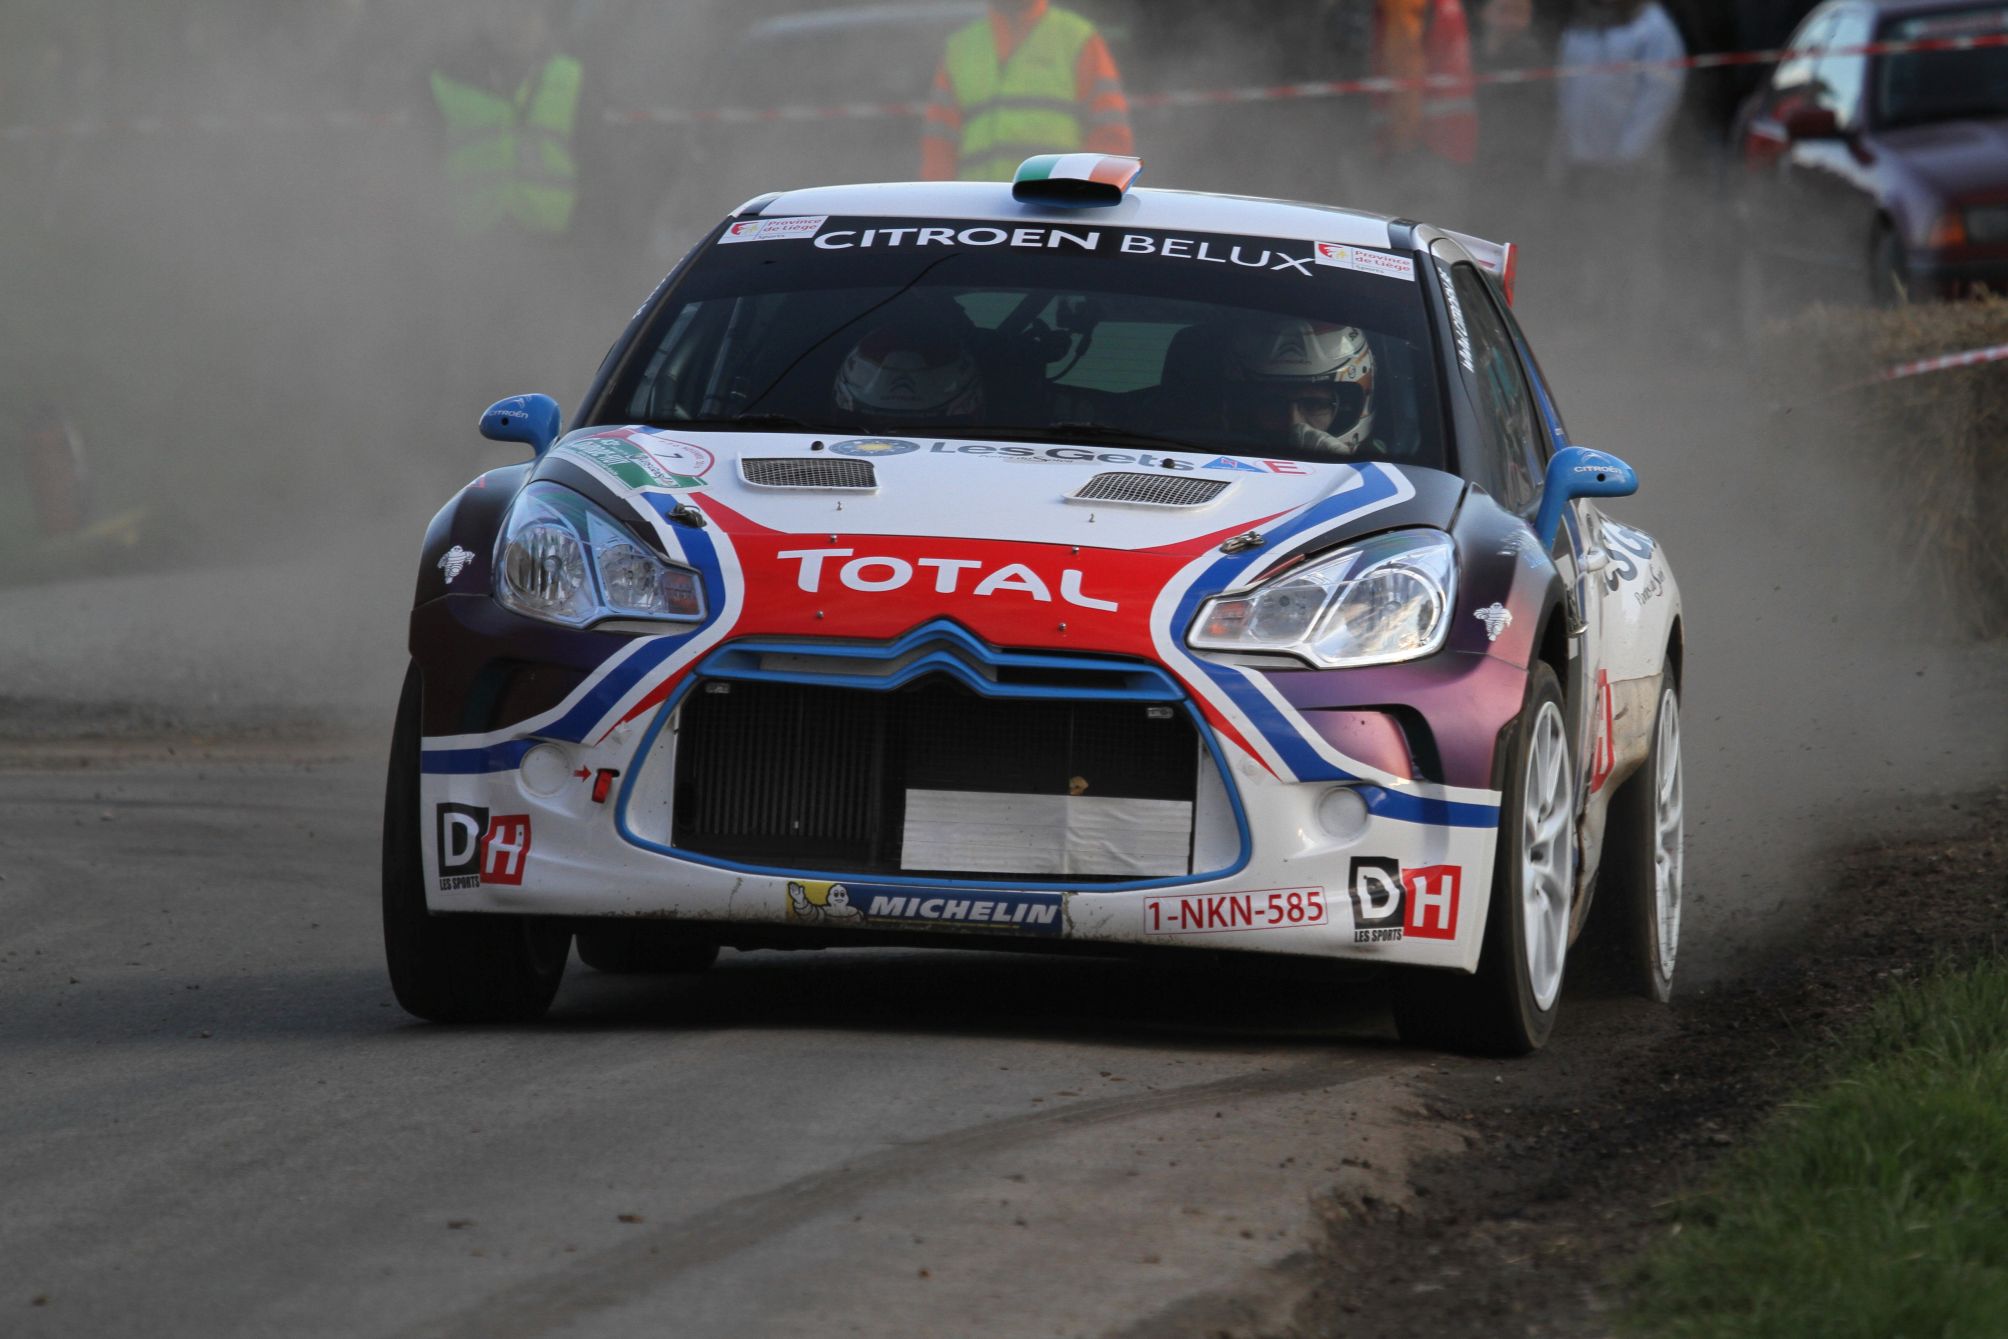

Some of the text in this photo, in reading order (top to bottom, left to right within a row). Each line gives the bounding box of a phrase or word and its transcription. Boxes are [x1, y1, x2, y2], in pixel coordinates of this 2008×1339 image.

[767, 218, 822, 227] Province
[814, 228, 1316, 277] CITROEN BELUX
[1355, 250, 1411, 266] Province
[930, 441, 1195, 472] Les Gets
[777, 548, 1119, 613] TOTAL
[440, 875, 480, 891] LES SPORTS
[868, 896, 1058, 924] MICHELIN
[1148, 891, 1324, 931] 1-NKN-585
[1354, 927, 1403, 943] LES SPORTS
